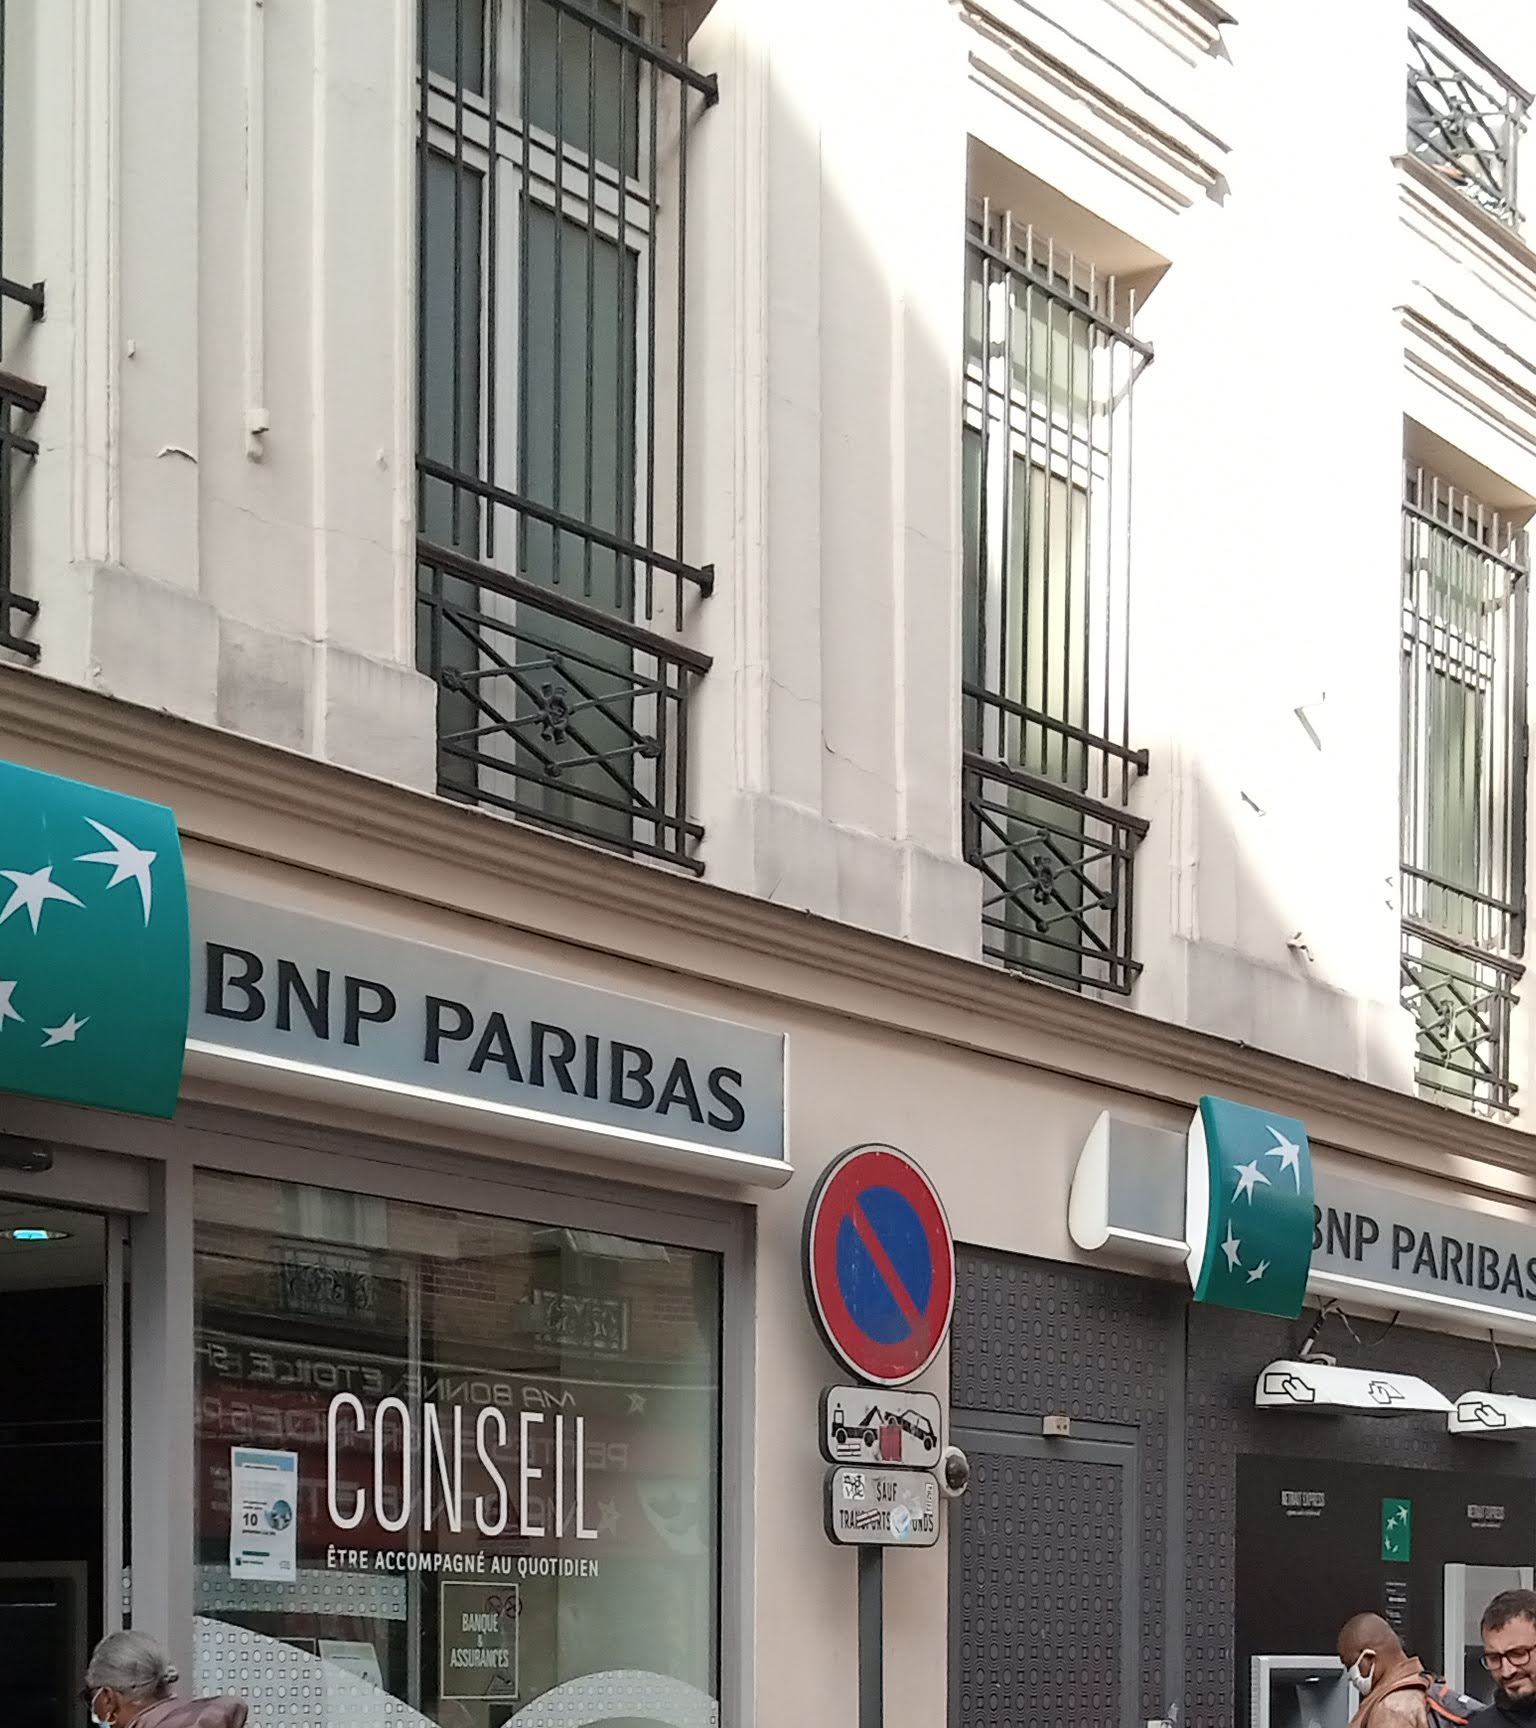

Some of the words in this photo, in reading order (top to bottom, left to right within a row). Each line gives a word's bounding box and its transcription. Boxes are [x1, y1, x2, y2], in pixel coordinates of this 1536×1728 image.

[204, 940, 397, 1047] BNP
[423, 994, 747, 1134] PARIBAS
[326, 1392, 600, 1541] CONSEIL
[876, 1481, 898, 1502] SAUF
[242, 1512, 259, 1527] 10
[327, 1544, 369, 1570] ÊTRE
[374, 1550, 486, 1574] ACCOMPAGNÉ
[490, 1557, 512, 1575] AU
[517, 1558, 599, 1579] QUOTIDIEN
[461, 1612, 499, 1634] BANQUE
[449, 1649, 510, 1669] ASSURANCES
